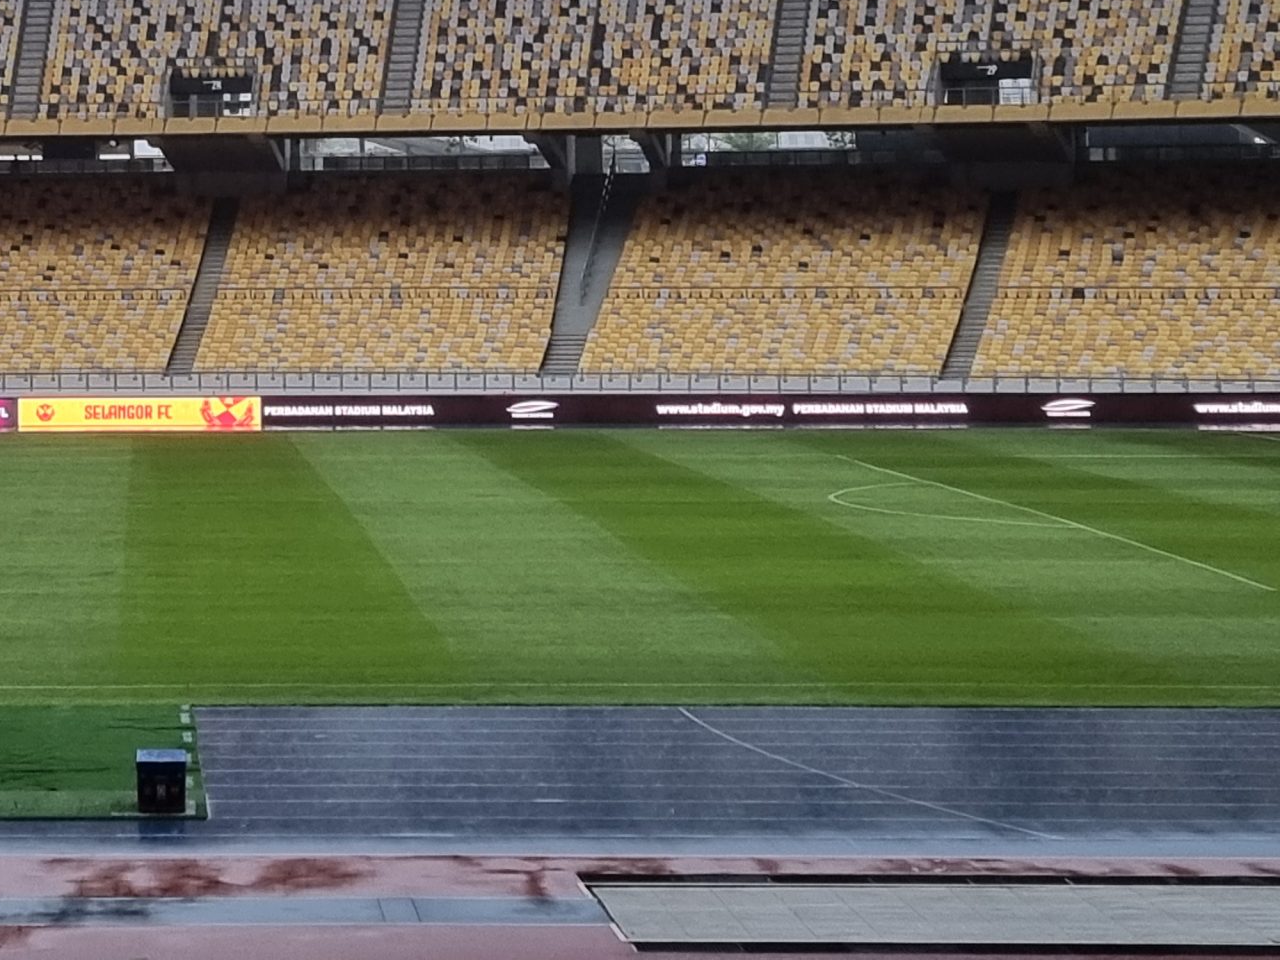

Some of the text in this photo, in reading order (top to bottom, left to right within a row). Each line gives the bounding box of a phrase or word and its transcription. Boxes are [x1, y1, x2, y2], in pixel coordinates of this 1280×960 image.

[84, 404, 173, 420] SELANGOR FC
[264, 404, 435, 417] PERBADANAN STADIUM MALAYSIA
[656, 402, 785, 416] www.stadium.gov.my
[865, 403, 913, 415] STADIUM
[914, 403, 968, 415] MALAYSIA
